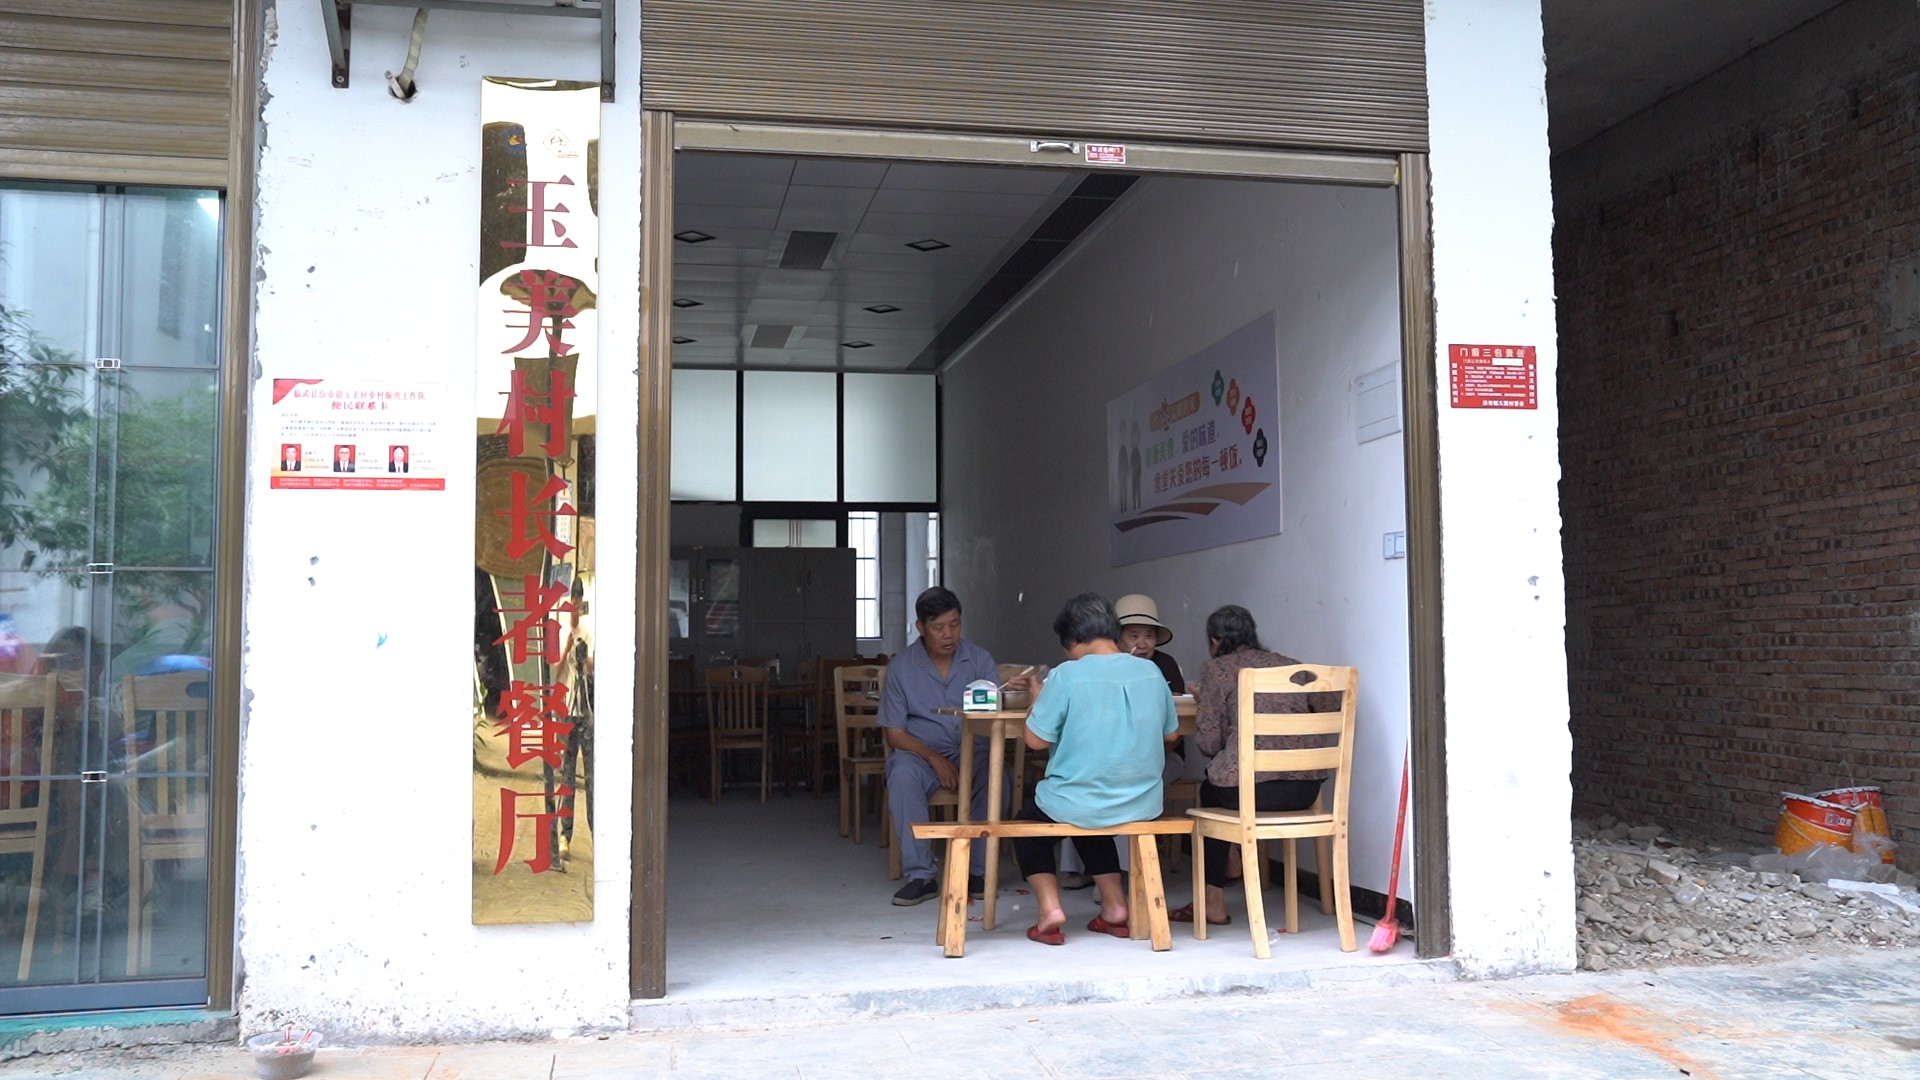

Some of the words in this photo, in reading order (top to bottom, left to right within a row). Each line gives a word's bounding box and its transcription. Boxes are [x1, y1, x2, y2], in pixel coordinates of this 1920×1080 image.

[331, 401, 389, 411] 便民联系卡
[492, 174, 578, 876] 玉美村长者餐厅
